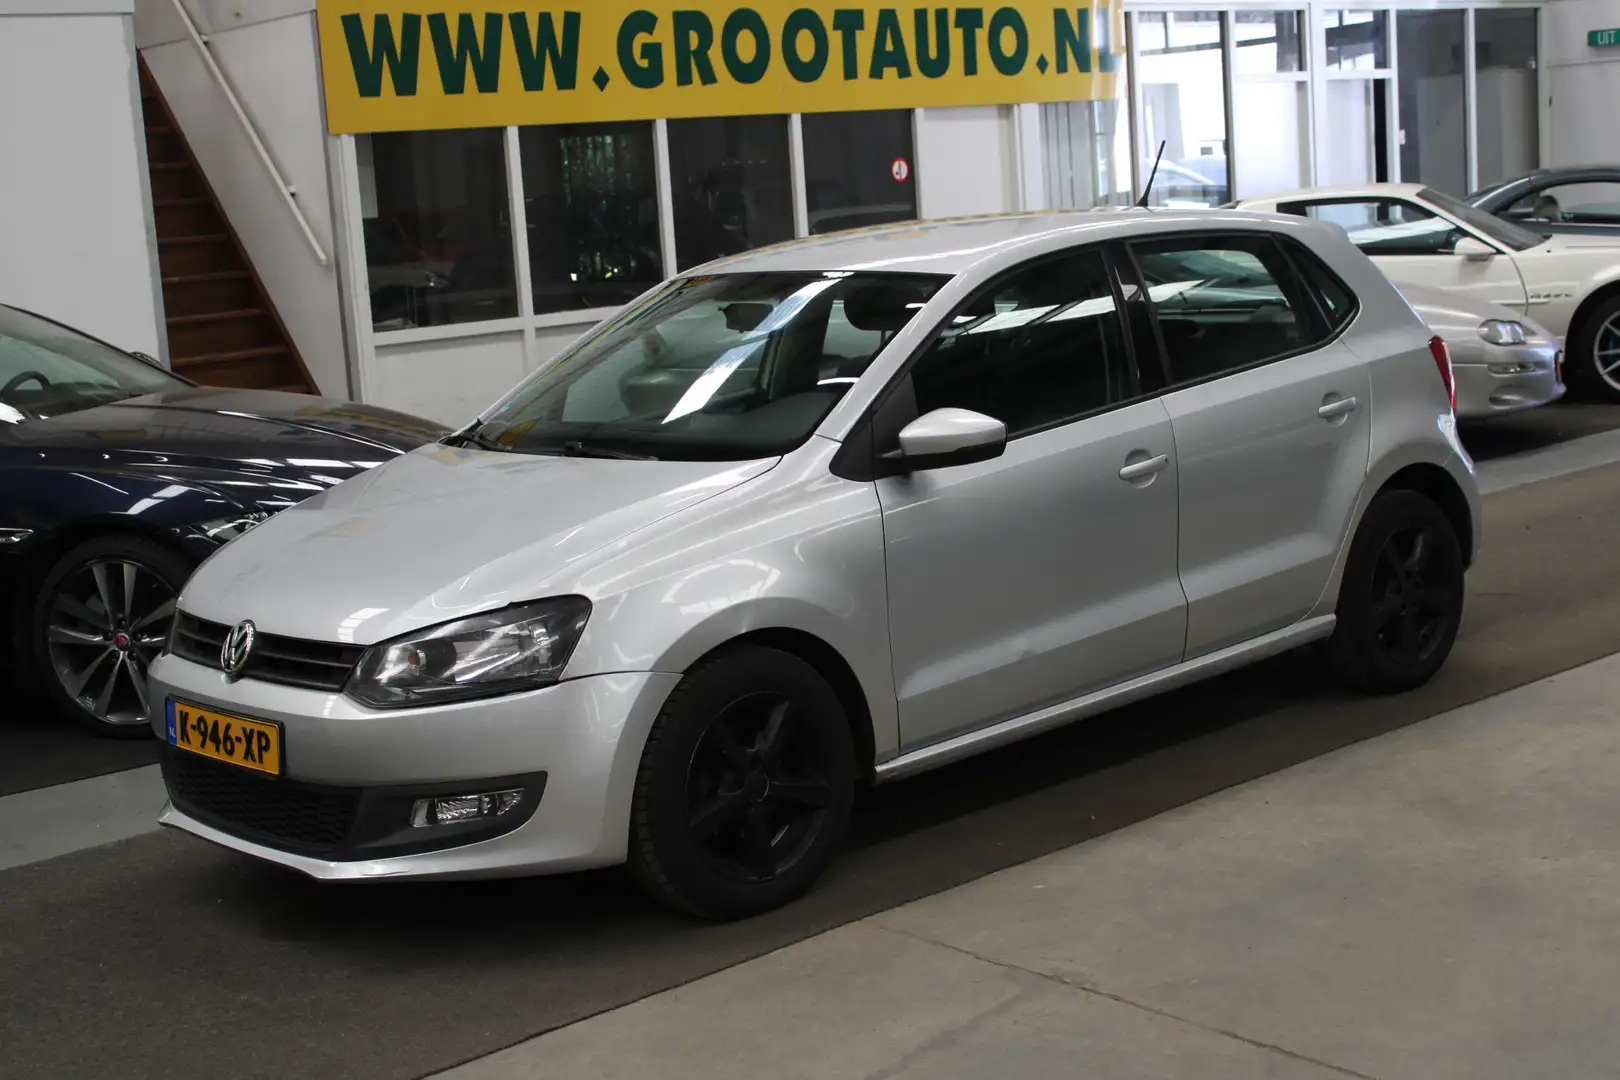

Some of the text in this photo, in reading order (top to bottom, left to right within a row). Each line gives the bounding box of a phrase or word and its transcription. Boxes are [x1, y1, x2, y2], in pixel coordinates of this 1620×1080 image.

[341, 7, 1120, 97] WWW.GROOTAUTO.NL
[1597, 31, 1616, 45] UIT
[179, 710, 271, 764] K-946-XP
